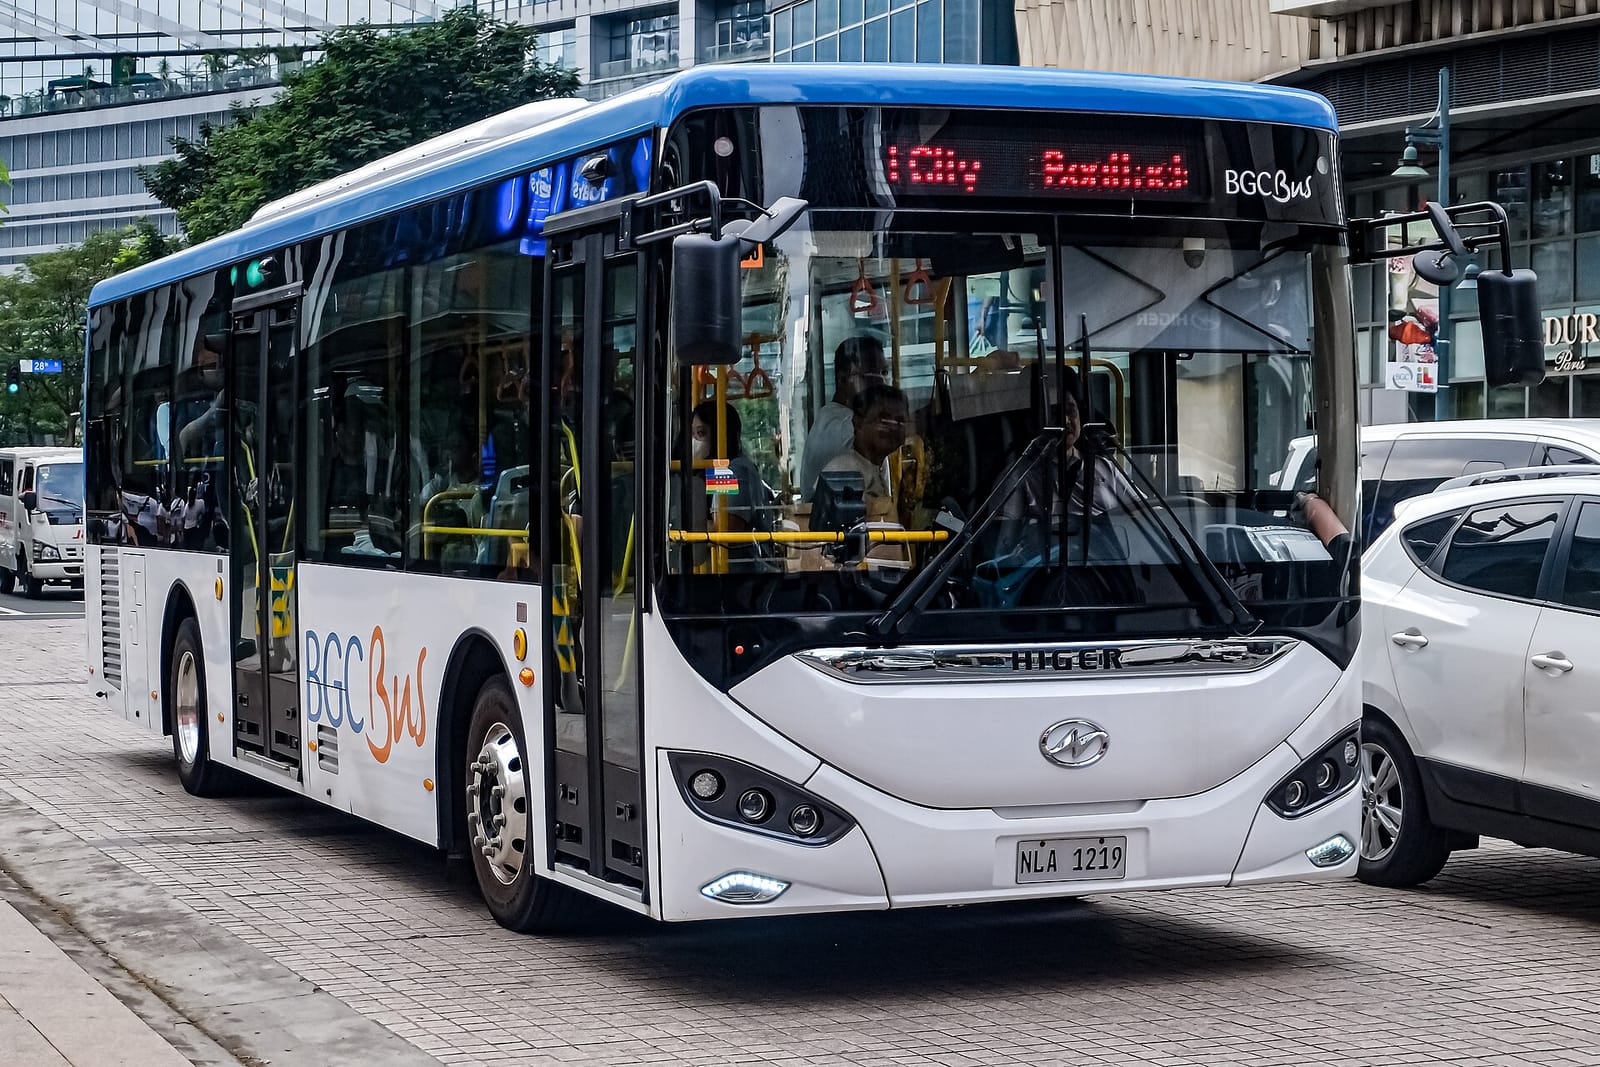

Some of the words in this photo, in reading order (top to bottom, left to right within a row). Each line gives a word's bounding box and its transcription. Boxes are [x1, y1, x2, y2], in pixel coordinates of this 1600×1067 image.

[1225, 169, 1272, 196] BGC
[1544, 313, 1600, 346] DUR
[1554, 350, 1586, 371] Paris
[1012, 648, 1122, 671] HIGER
[306, 629, 365, 734] BGC
[365, 624, 427, 764] Bus
[1020, 849, 1057, 874] NLA
[1072, 846, 1122, 871] 1219
